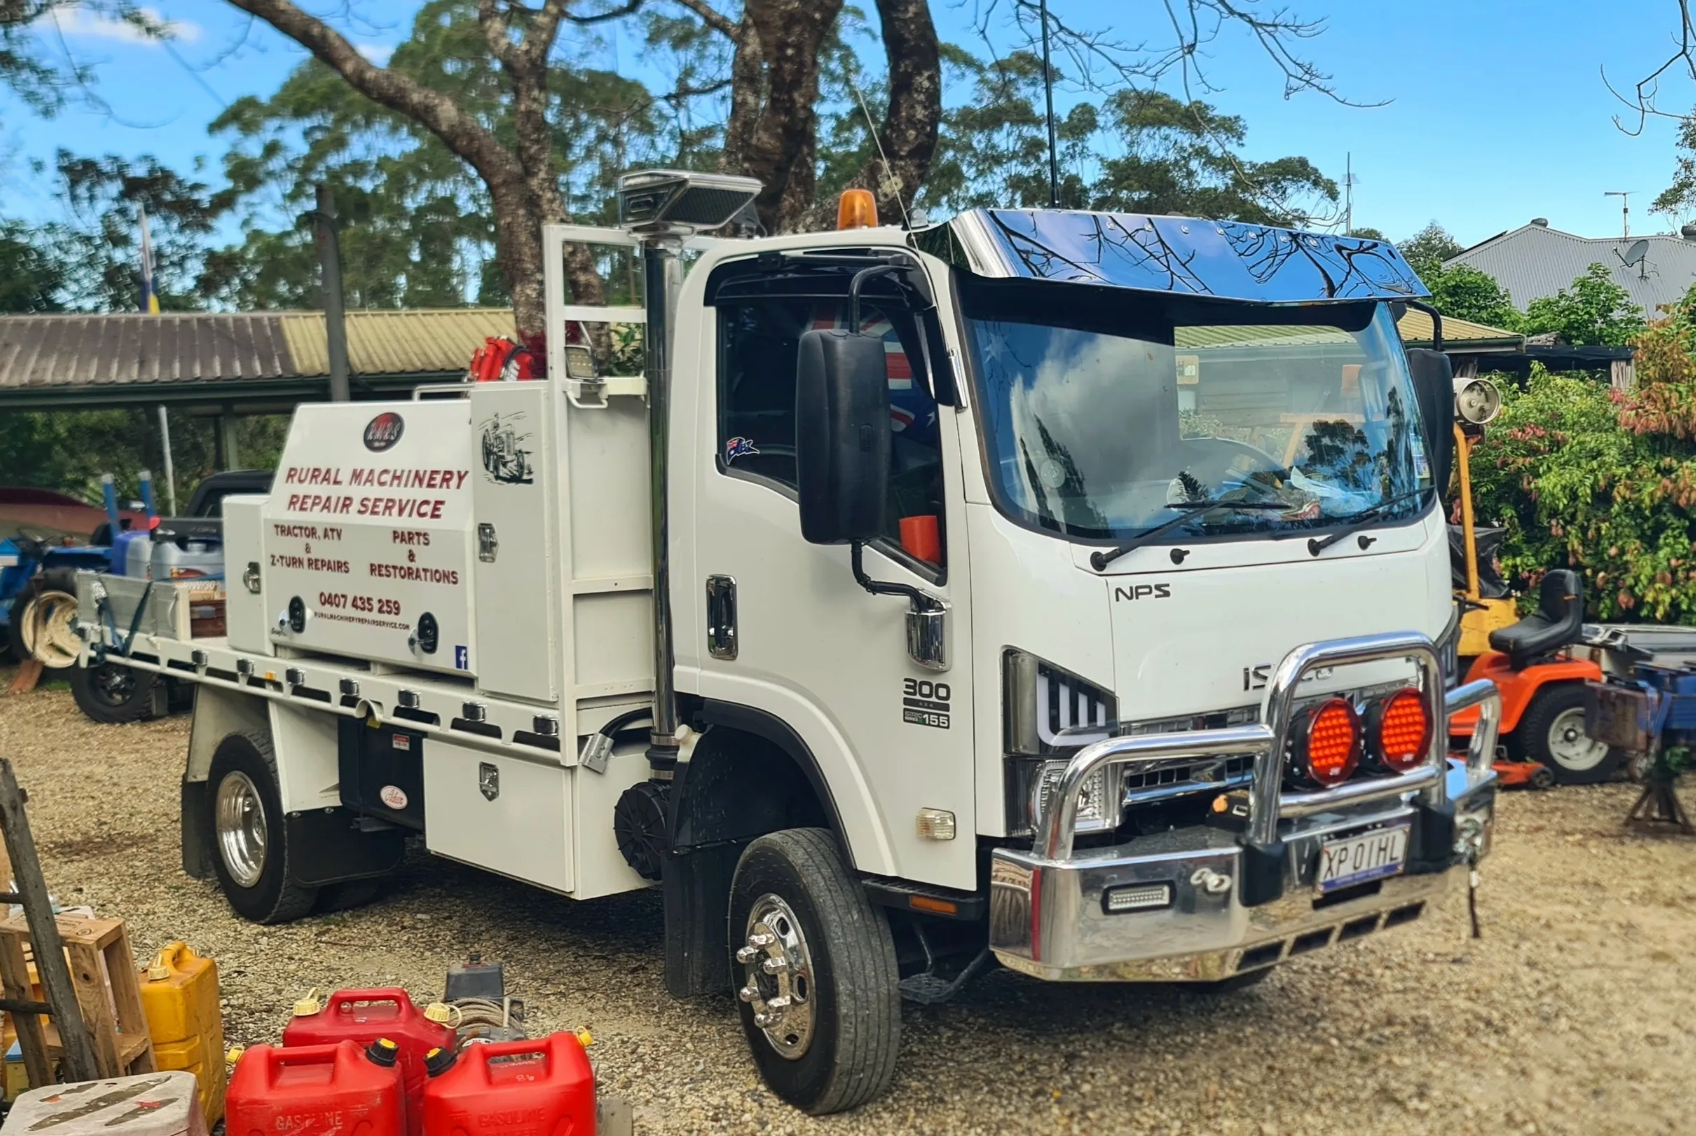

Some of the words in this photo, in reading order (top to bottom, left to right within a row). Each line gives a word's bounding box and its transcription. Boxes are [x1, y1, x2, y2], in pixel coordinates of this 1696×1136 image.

[285, 467, 343, 486] RURAL
[349, 468, 469, 490] MACHINERY
[287, 494, 353, 514] REPAIR
[357, 497, 445, 519] SERVICE
[274, 524, 321, 541] TRACTOR,
[323, 527, 342, 541] ATV
[393, 530, 430, 546] PARTS
[305, 542, 311, 554] &
[408, 549, 416, 563] &
[270, 554, 304, 569] Z-TURN
[307, 557, 350, 574] REPAIRS
[369, 563, 459, 585] RESTORATIONS
[1115, 583, 1171, 602] NPS
[319, 592, 348, 609] 0407
[351, 595, 374, 612] 435
[377, 598, 401, 616] 259
[903, 677, 951, 701] 300
[922, 714, 949, 727] 155
